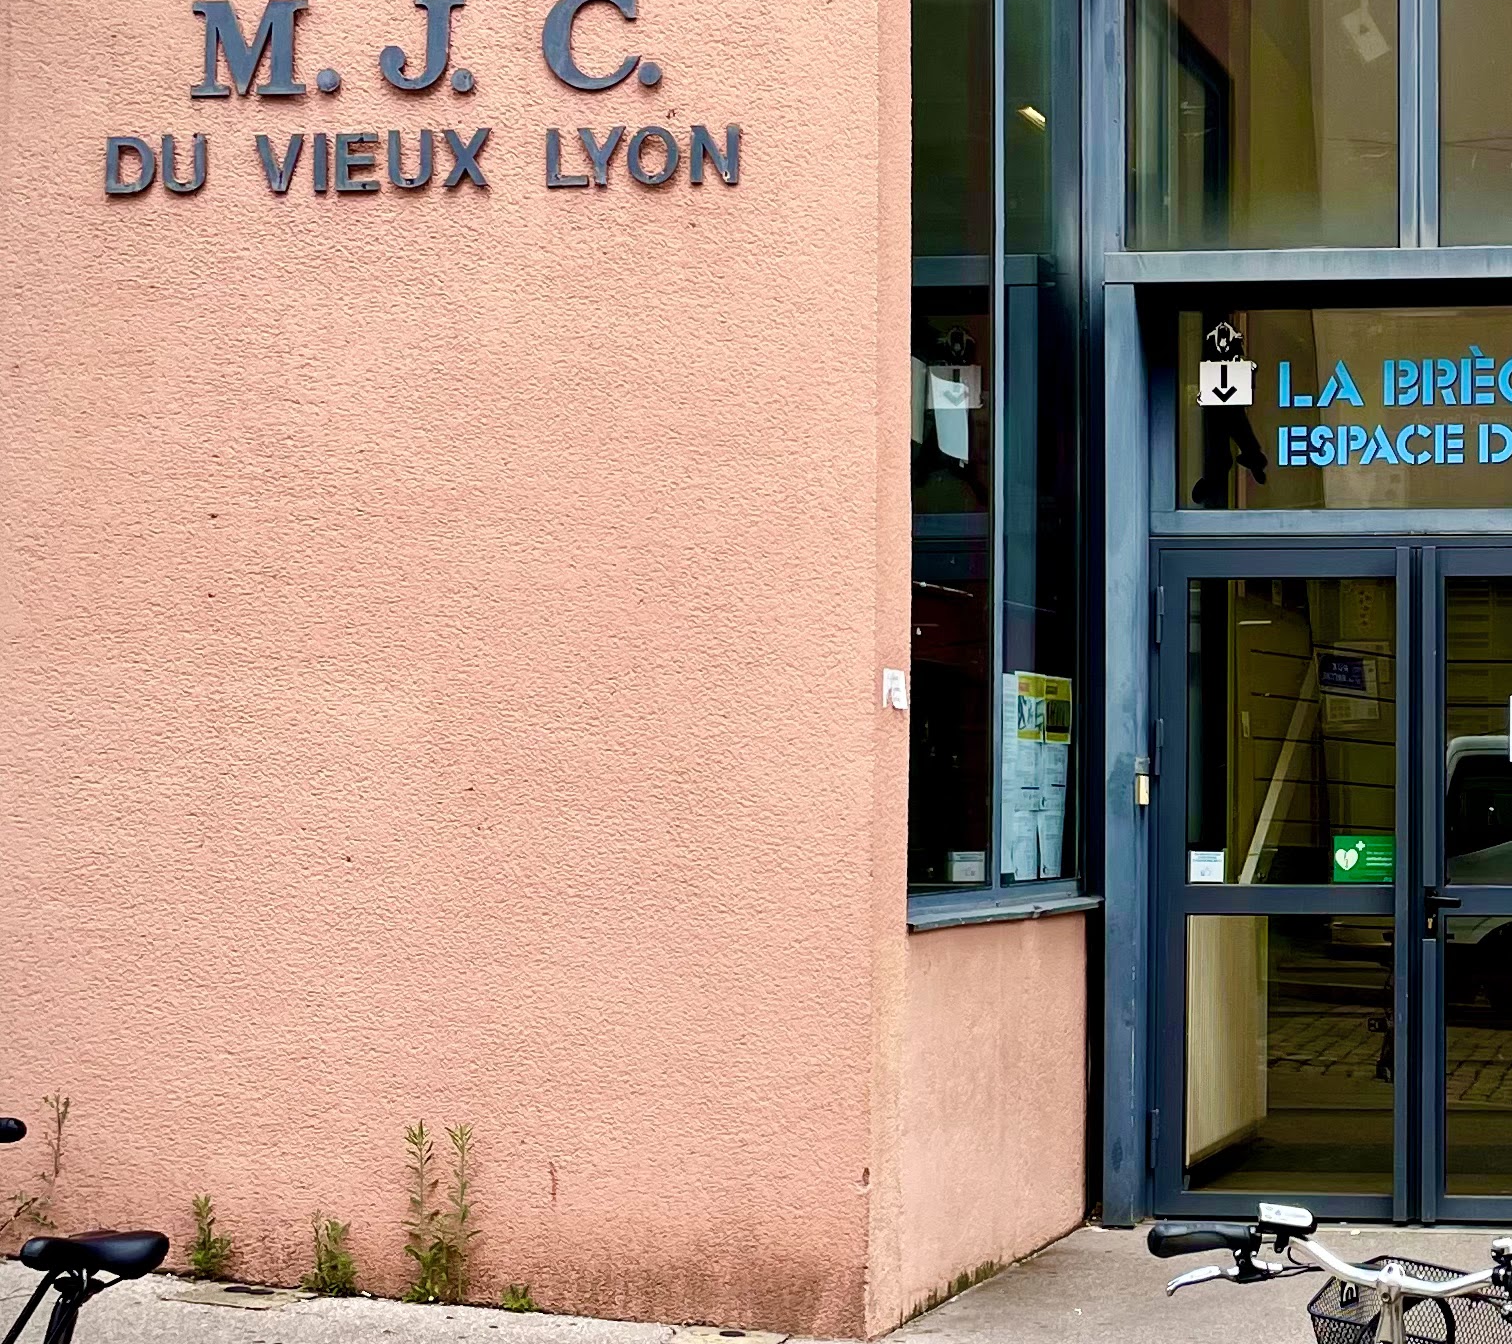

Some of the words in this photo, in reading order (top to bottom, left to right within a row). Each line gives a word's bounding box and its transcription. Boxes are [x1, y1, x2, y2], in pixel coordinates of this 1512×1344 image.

[105, 132, 208, 195] DU
[256, 126, 492, 193] VIEUX
[545, 123, 741, 189] LYON
[1278, 359, 1364, 408] LA
[1278, 423, 1465, 465] ESPACE
